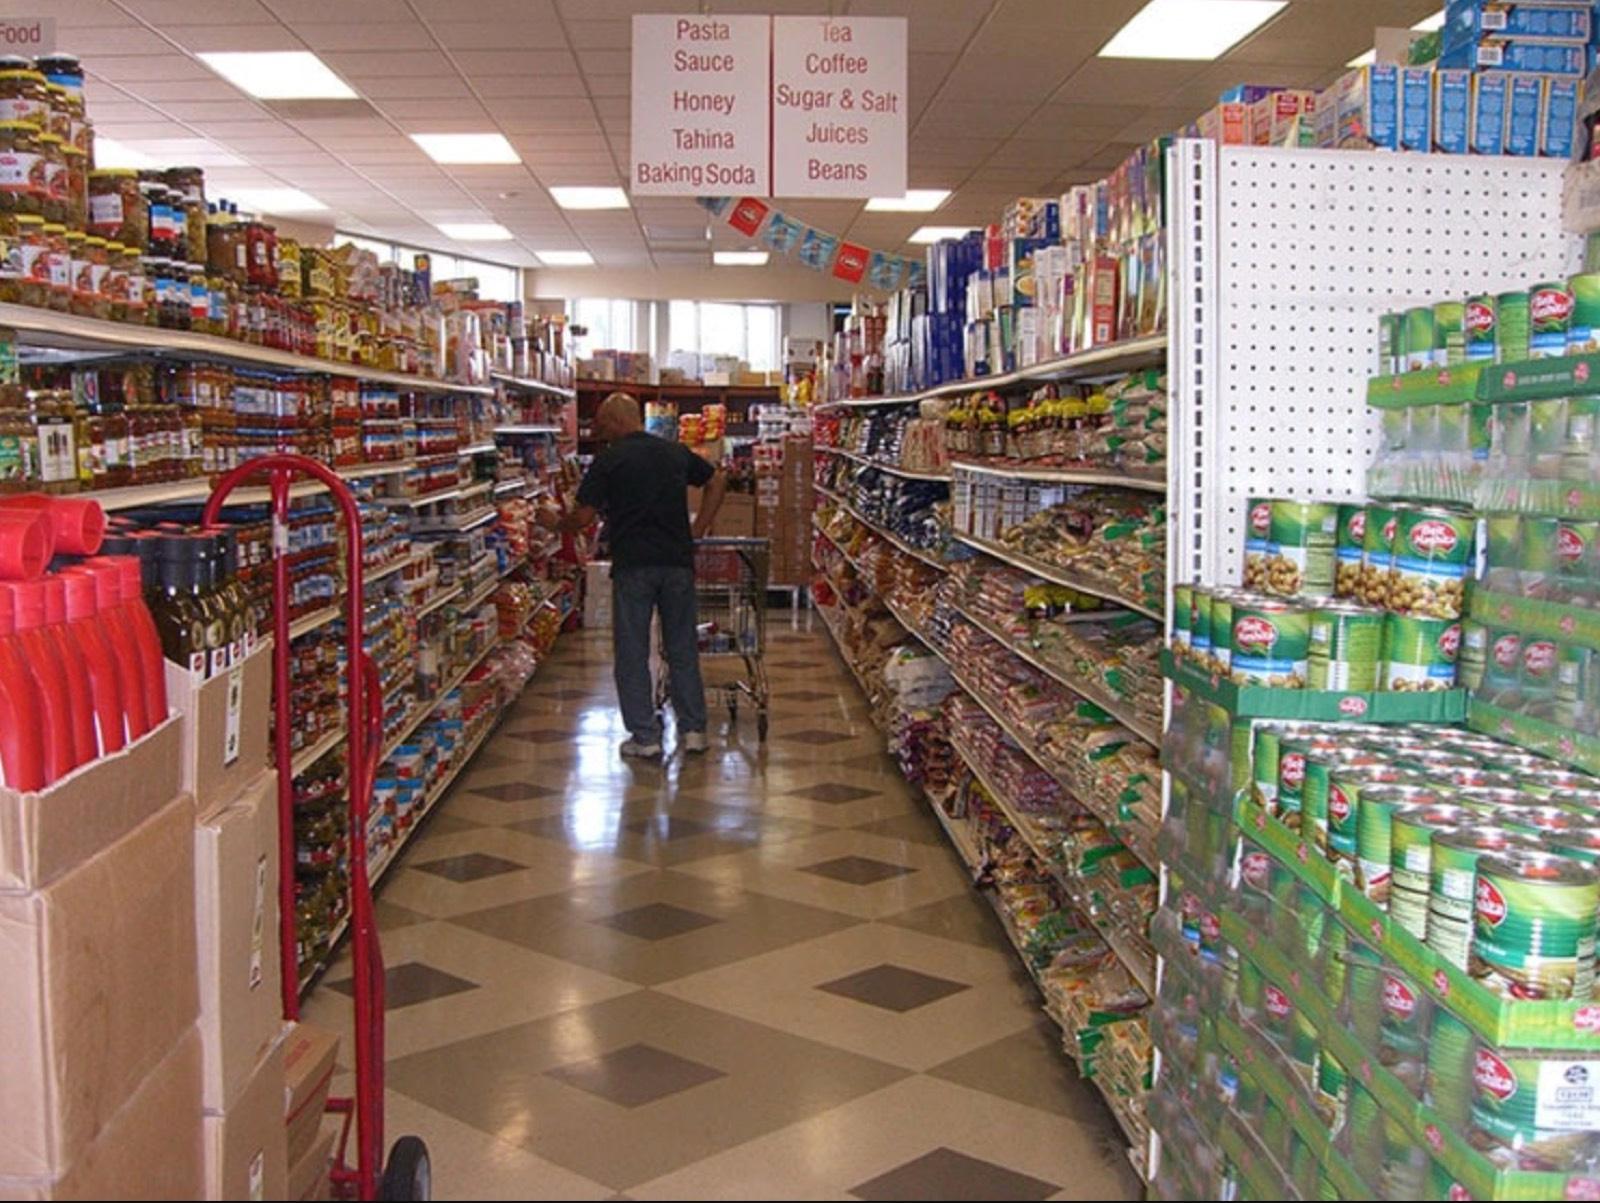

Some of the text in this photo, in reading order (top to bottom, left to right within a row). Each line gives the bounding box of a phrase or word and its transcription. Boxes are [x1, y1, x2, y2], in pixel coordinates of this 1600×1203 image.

[676, 19, 730, 41] Pasta
[821, 21, 852, 42] Tea
[673, 49, 735, 72] Sauce
[805, 52, 869, 74] Coffee
[673, 90, 736, 116] Honey
[776, 83, 898, 113] Sugar & Salt
[672, 128, 735, 151] Tahina
[805, 122, 870, 145] Juices
[637, 161, 756, 188] Baking Soda
[807, 158, 868, 181] Beans
